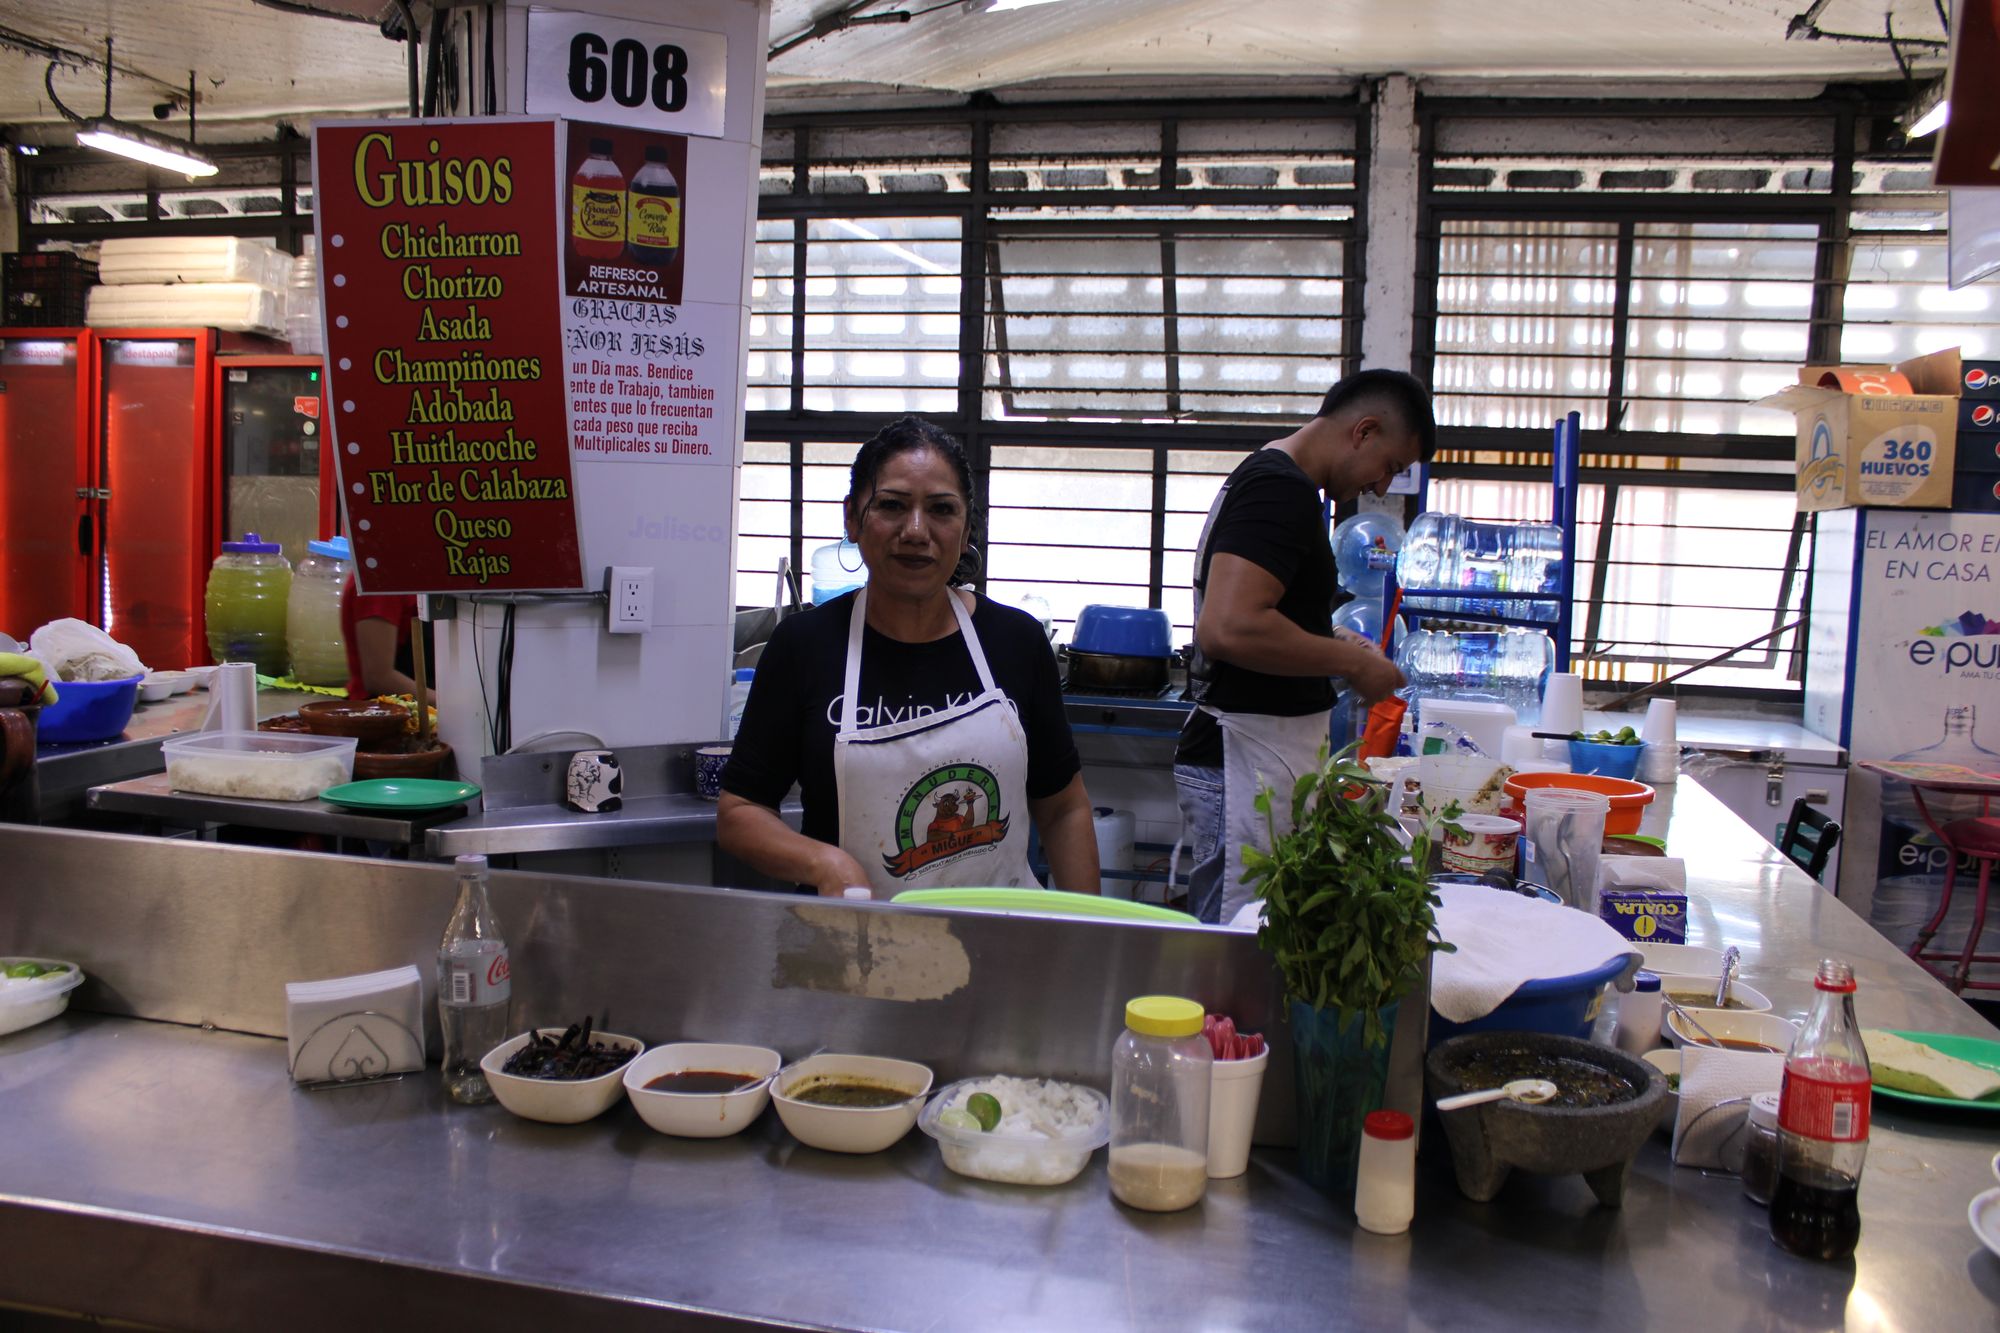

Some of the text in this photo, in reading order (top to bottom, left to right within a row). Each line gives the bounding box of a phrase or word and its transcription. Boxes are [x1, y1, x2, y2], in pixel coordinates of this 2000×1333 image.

[568, 33, 688, 113] 608
[354, 133, 513, 207] Guisos
[381, 223, 520, 259] Chicharron
[403, 265, 502, 301] Chorizo
[589, 265, 658, 283] REFRESCO
[577, 279, 667, 299] ARTESANAL
[418, 307, 492, 342] Asada
[573, 298, 678, 328] GRACIAS
[374, 348, 541, 390] Champiñones
[573, 360, 693, 380] un Día mas. Bendice
[600, 380, 614, 395] de
[618, 380, 663, 400] Trabajo,
[669, 384, 714, 400] tambien
[408, 388, 514, 424] Adobada
[611, 402, 632, 417] que
[637, 400, 646, 415] lo
[651, 401, 713, 418] frecuentan
[574, 417, 698, 437] cada peso que reciba
[391, 428, 537, 464] Huitlacoche
[574, 435, 712, 455] Multiplicales su Dinero.
[1883, 440, 1932, 461] 360
[1861, 462, 1930, 476] HUEVOS
[369, 468, 568, 503] Flor de Calabaza
[435, 509, 511, 546] Queso
[1866, 530, 1887, 549] EL
[1894, 532, 1973, 552] AMOR
[447, 546, 510, 584] Rajas
[1885, 560, 1991, 582] EN CASA
[1613, 903, 1679, 915] CUALPA
